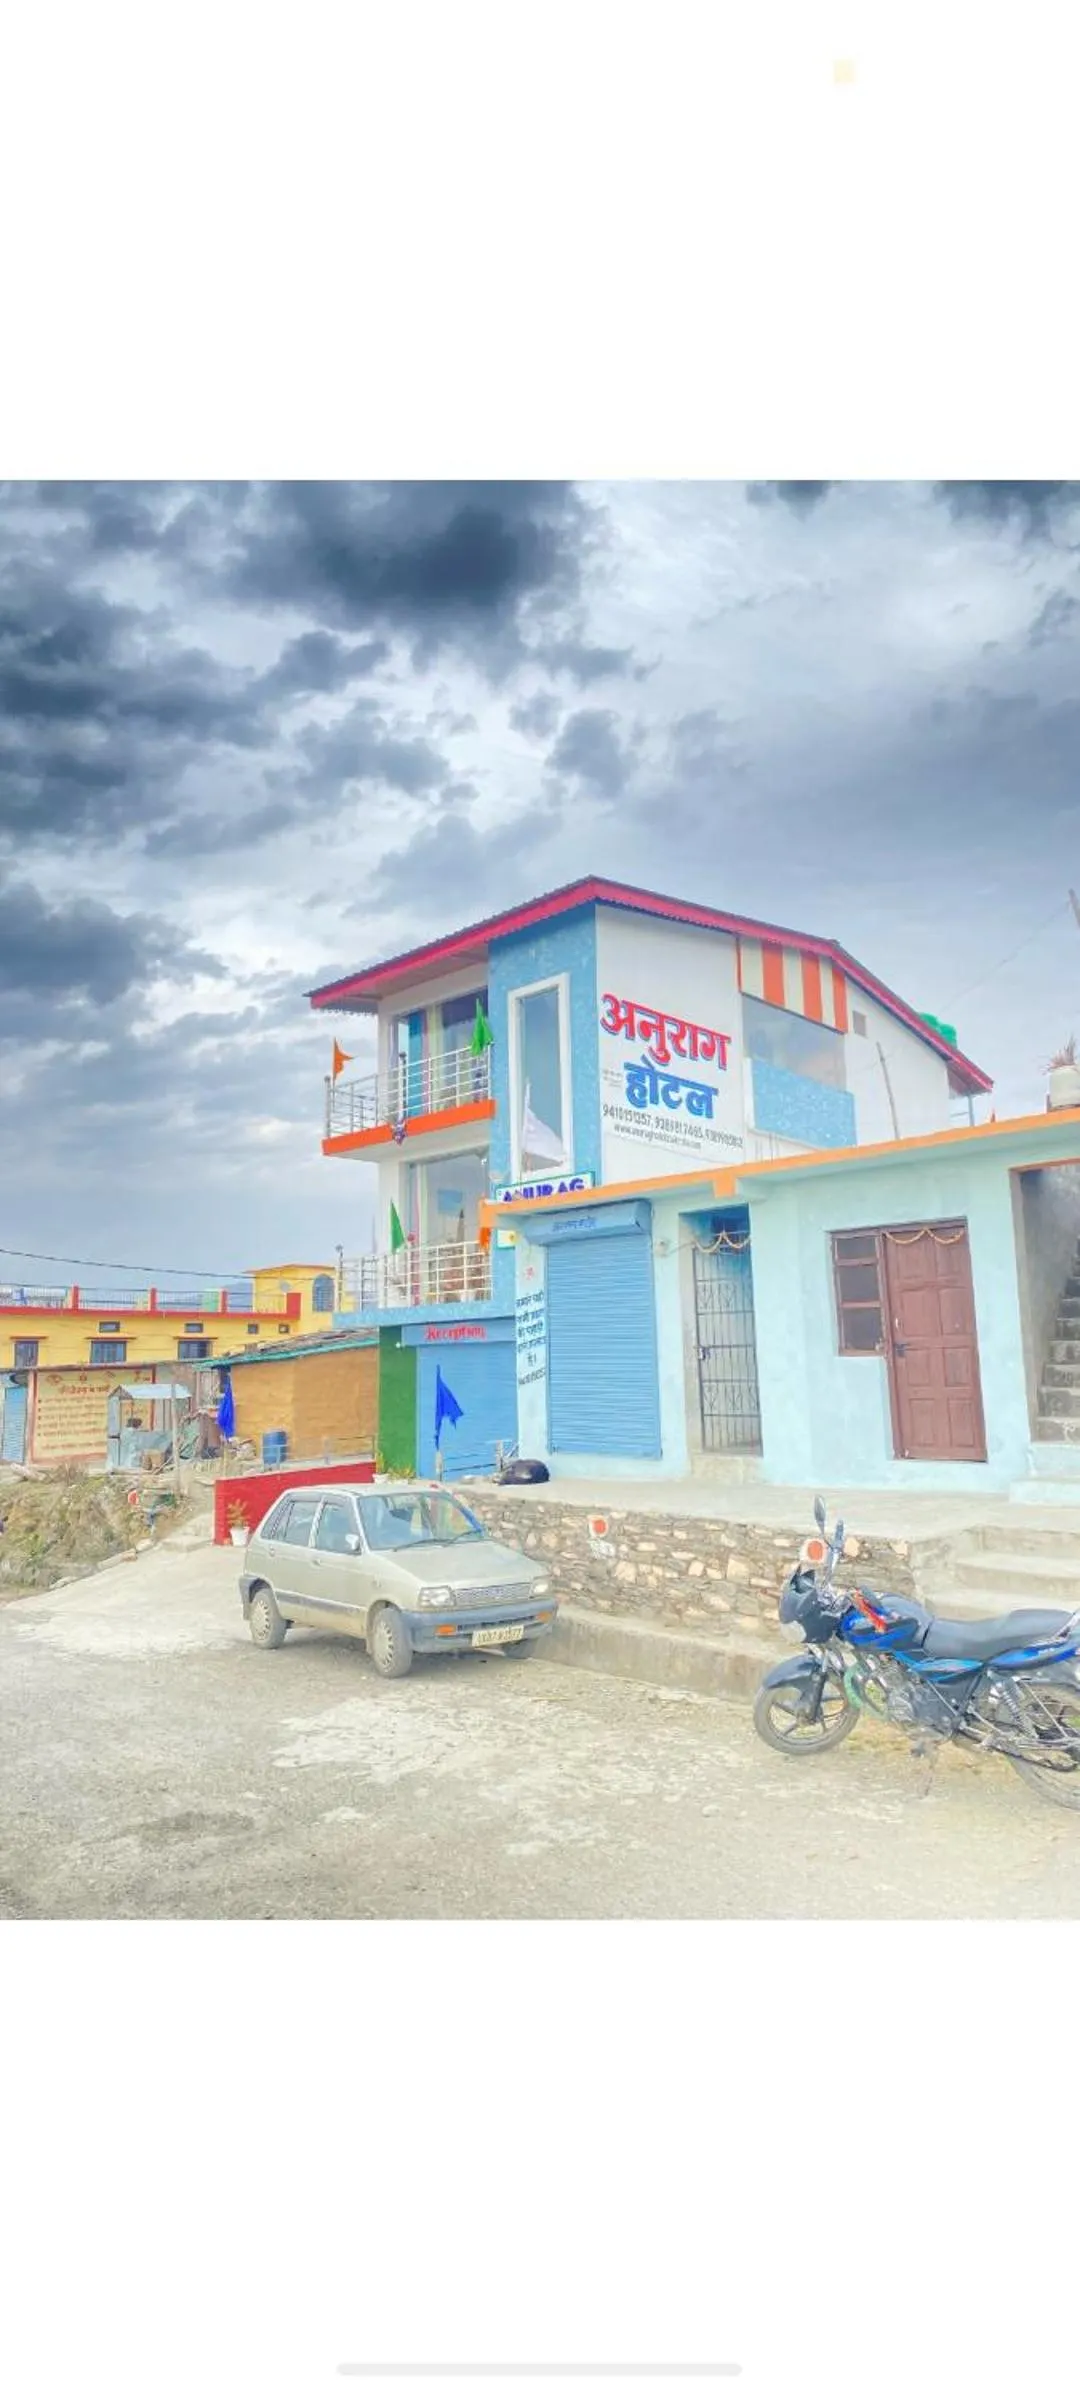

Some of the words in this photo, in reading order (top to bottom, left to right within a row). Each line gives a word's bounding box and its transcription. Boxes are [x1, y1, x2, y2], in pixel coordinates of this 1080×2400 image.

[600, 993, 731, 1071] अनुराग
[623, 1054, 719, 1119] होटल
[503, 1178, 585, 1202] AURAG
